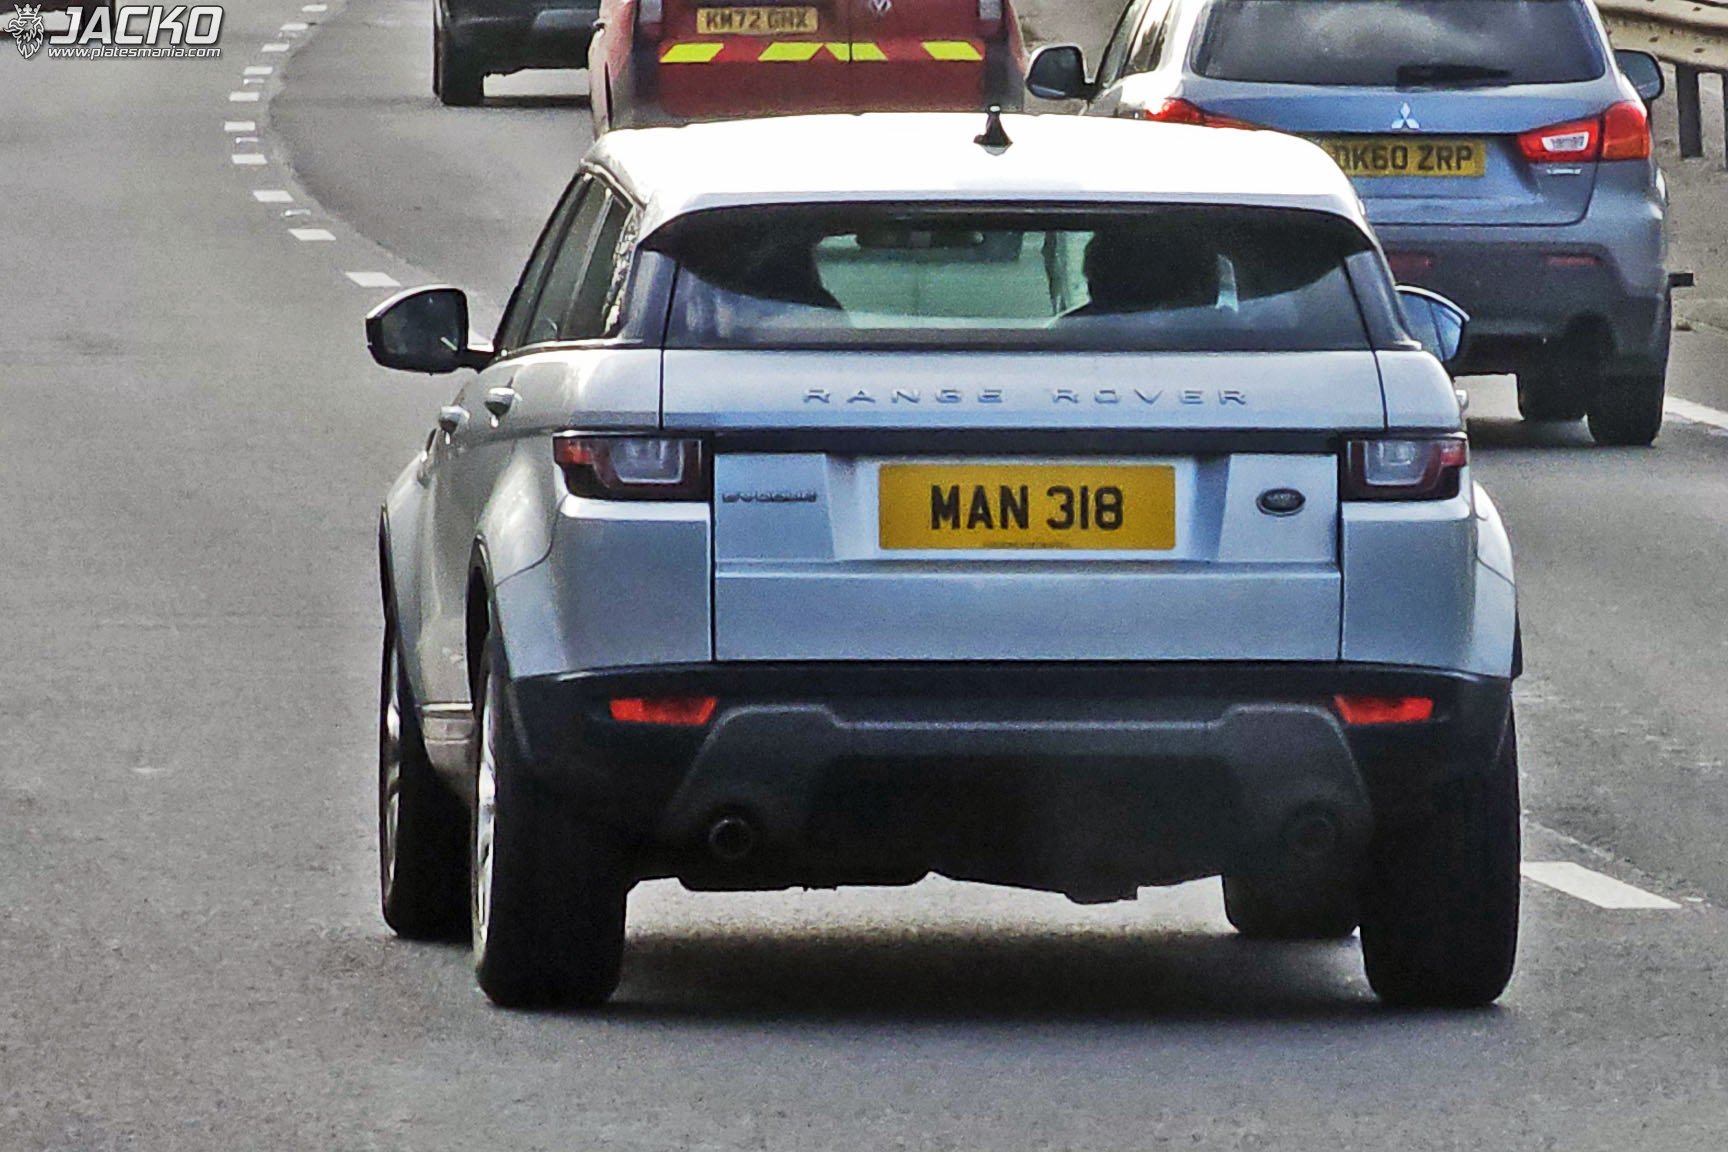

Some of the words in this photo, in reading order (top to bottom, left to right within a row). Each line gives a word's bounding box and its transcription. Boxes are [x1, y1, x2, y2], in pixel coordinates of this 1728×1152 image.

[1418, 145, 1473, 170] ZRP
[803, 388, 1003, 404] RANGE
[1052, 388, 1246, 405] ROVER
[931, 484, 1029, 530] MAN
[1046, 485, 1124, 530] 318
